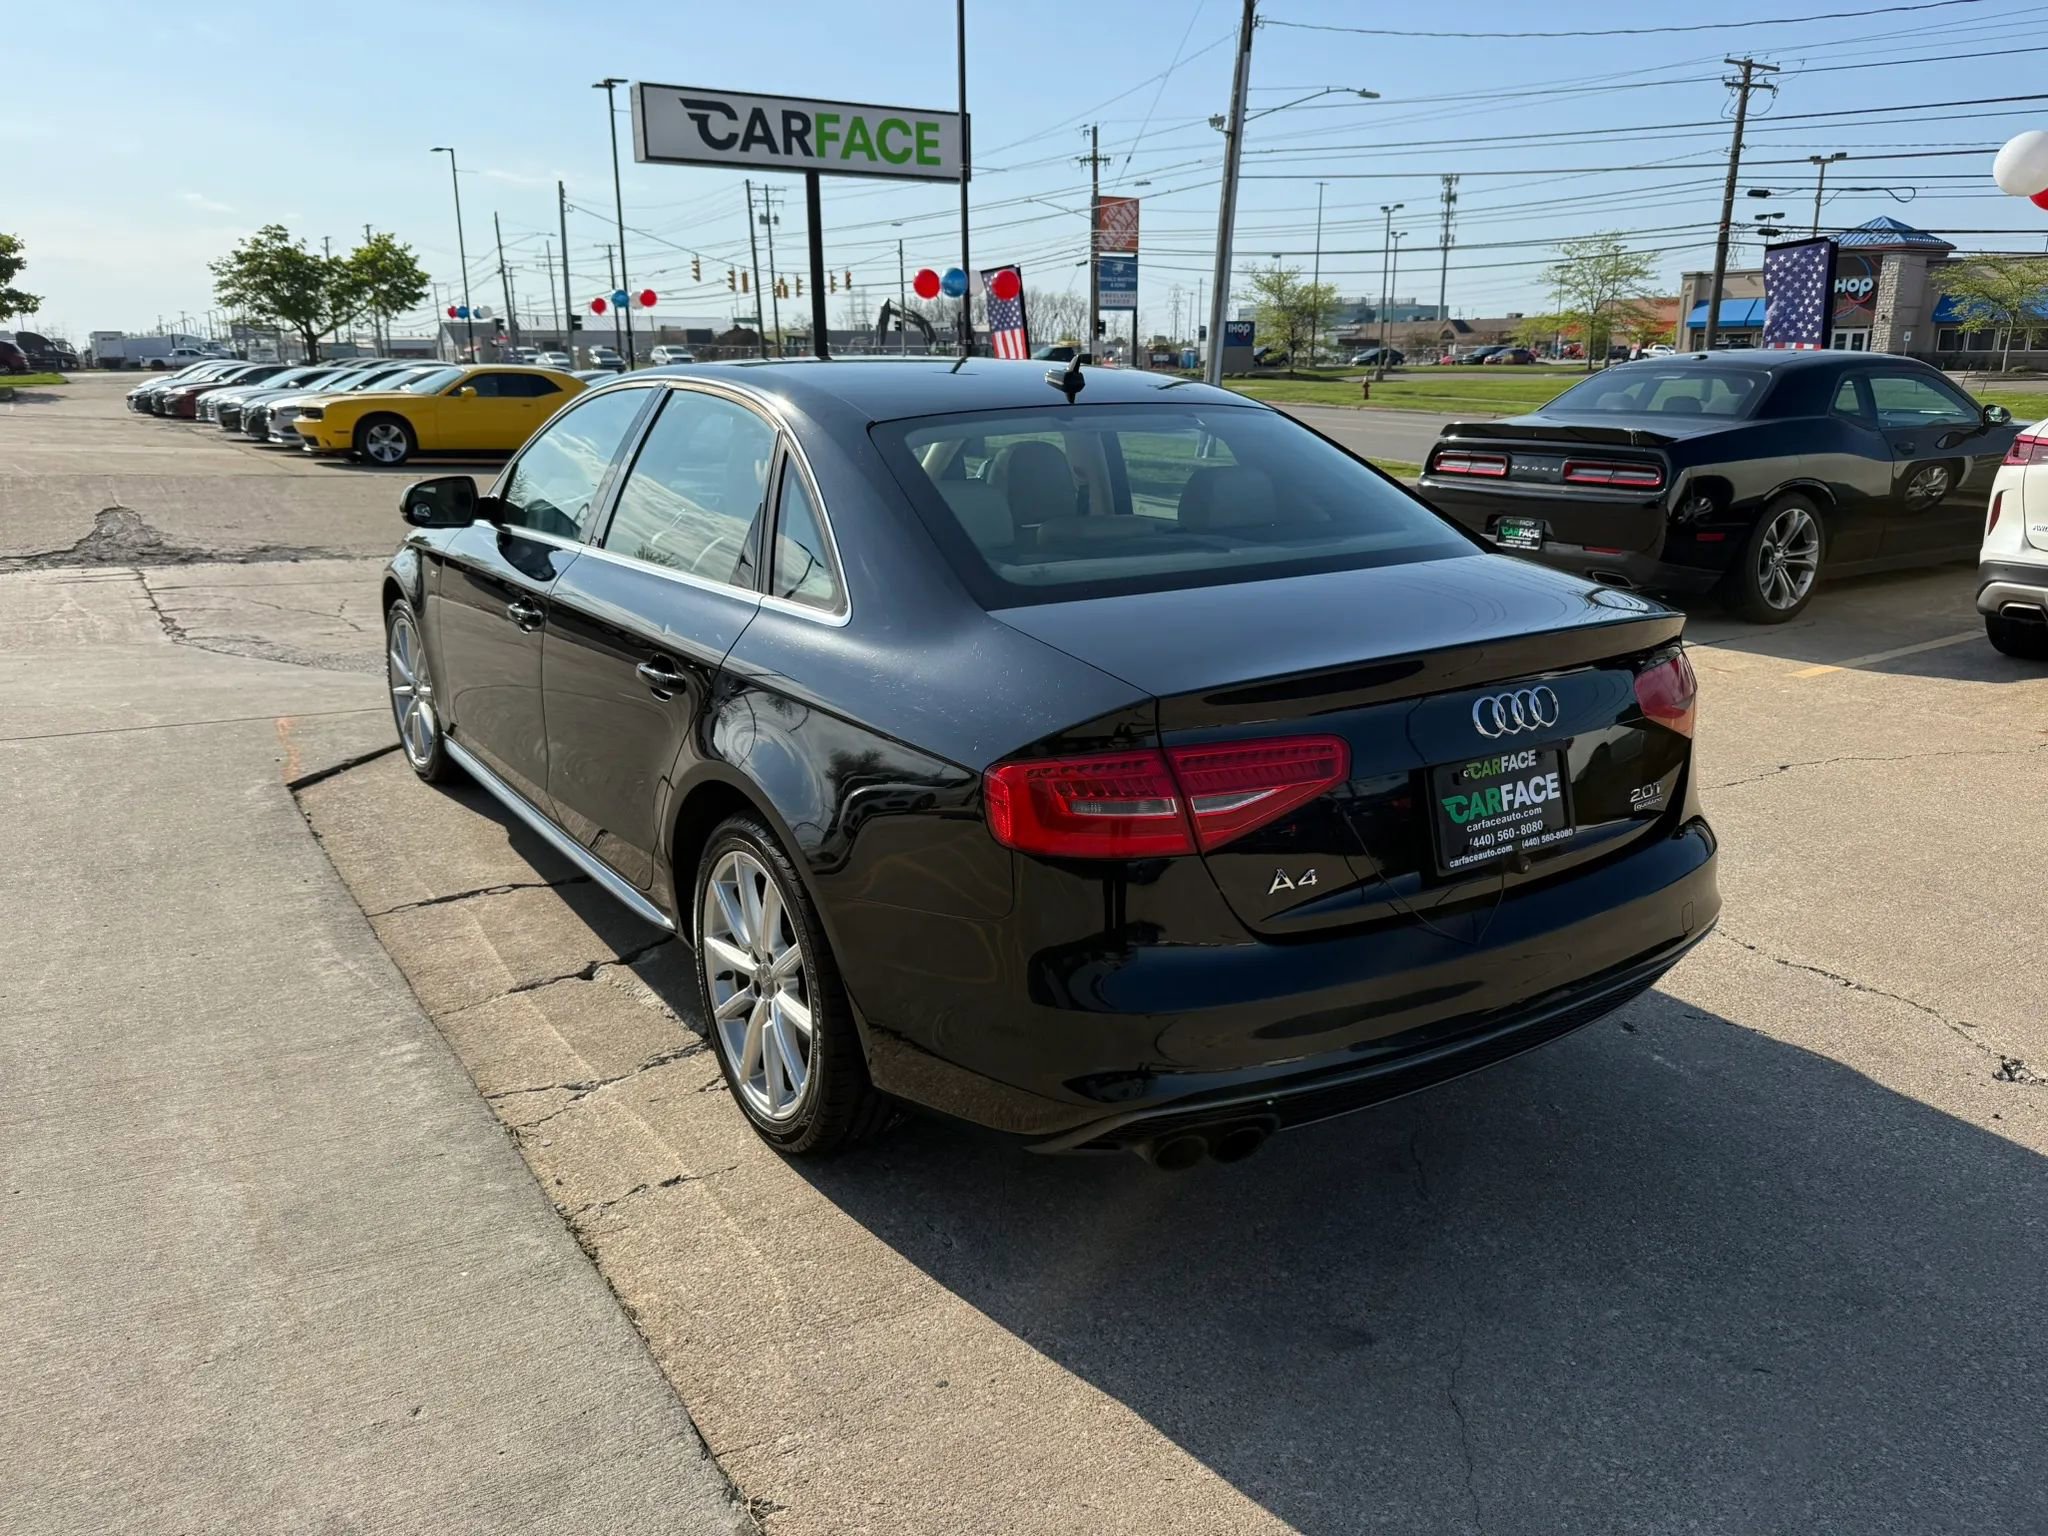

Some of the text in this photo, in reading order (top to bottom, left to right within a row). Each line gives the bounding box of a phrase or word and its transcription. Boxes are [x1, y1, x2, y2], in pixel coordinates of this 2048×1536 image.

[678, 97, 941, 167] CARFACE
[1833, 277, 1874, 297] HOP
[1227, 323, 1251, 337] IHOP
[1501, 526, 1540, 538] CARFACE
[1466, 749, 1537, 779] CARFACE
[1441, 772, 1561, 824] CARFACE
[1630, 780, 1663, 803] 2.0T
[1466, 807, 1542, 833] carfaceauto.com
[1449, 828, 1574, 868] carfaceauto.com (440) 560-8080
[1469, 833, 1495, 848] (440)
[1267, 868, 1319, 895] A4
